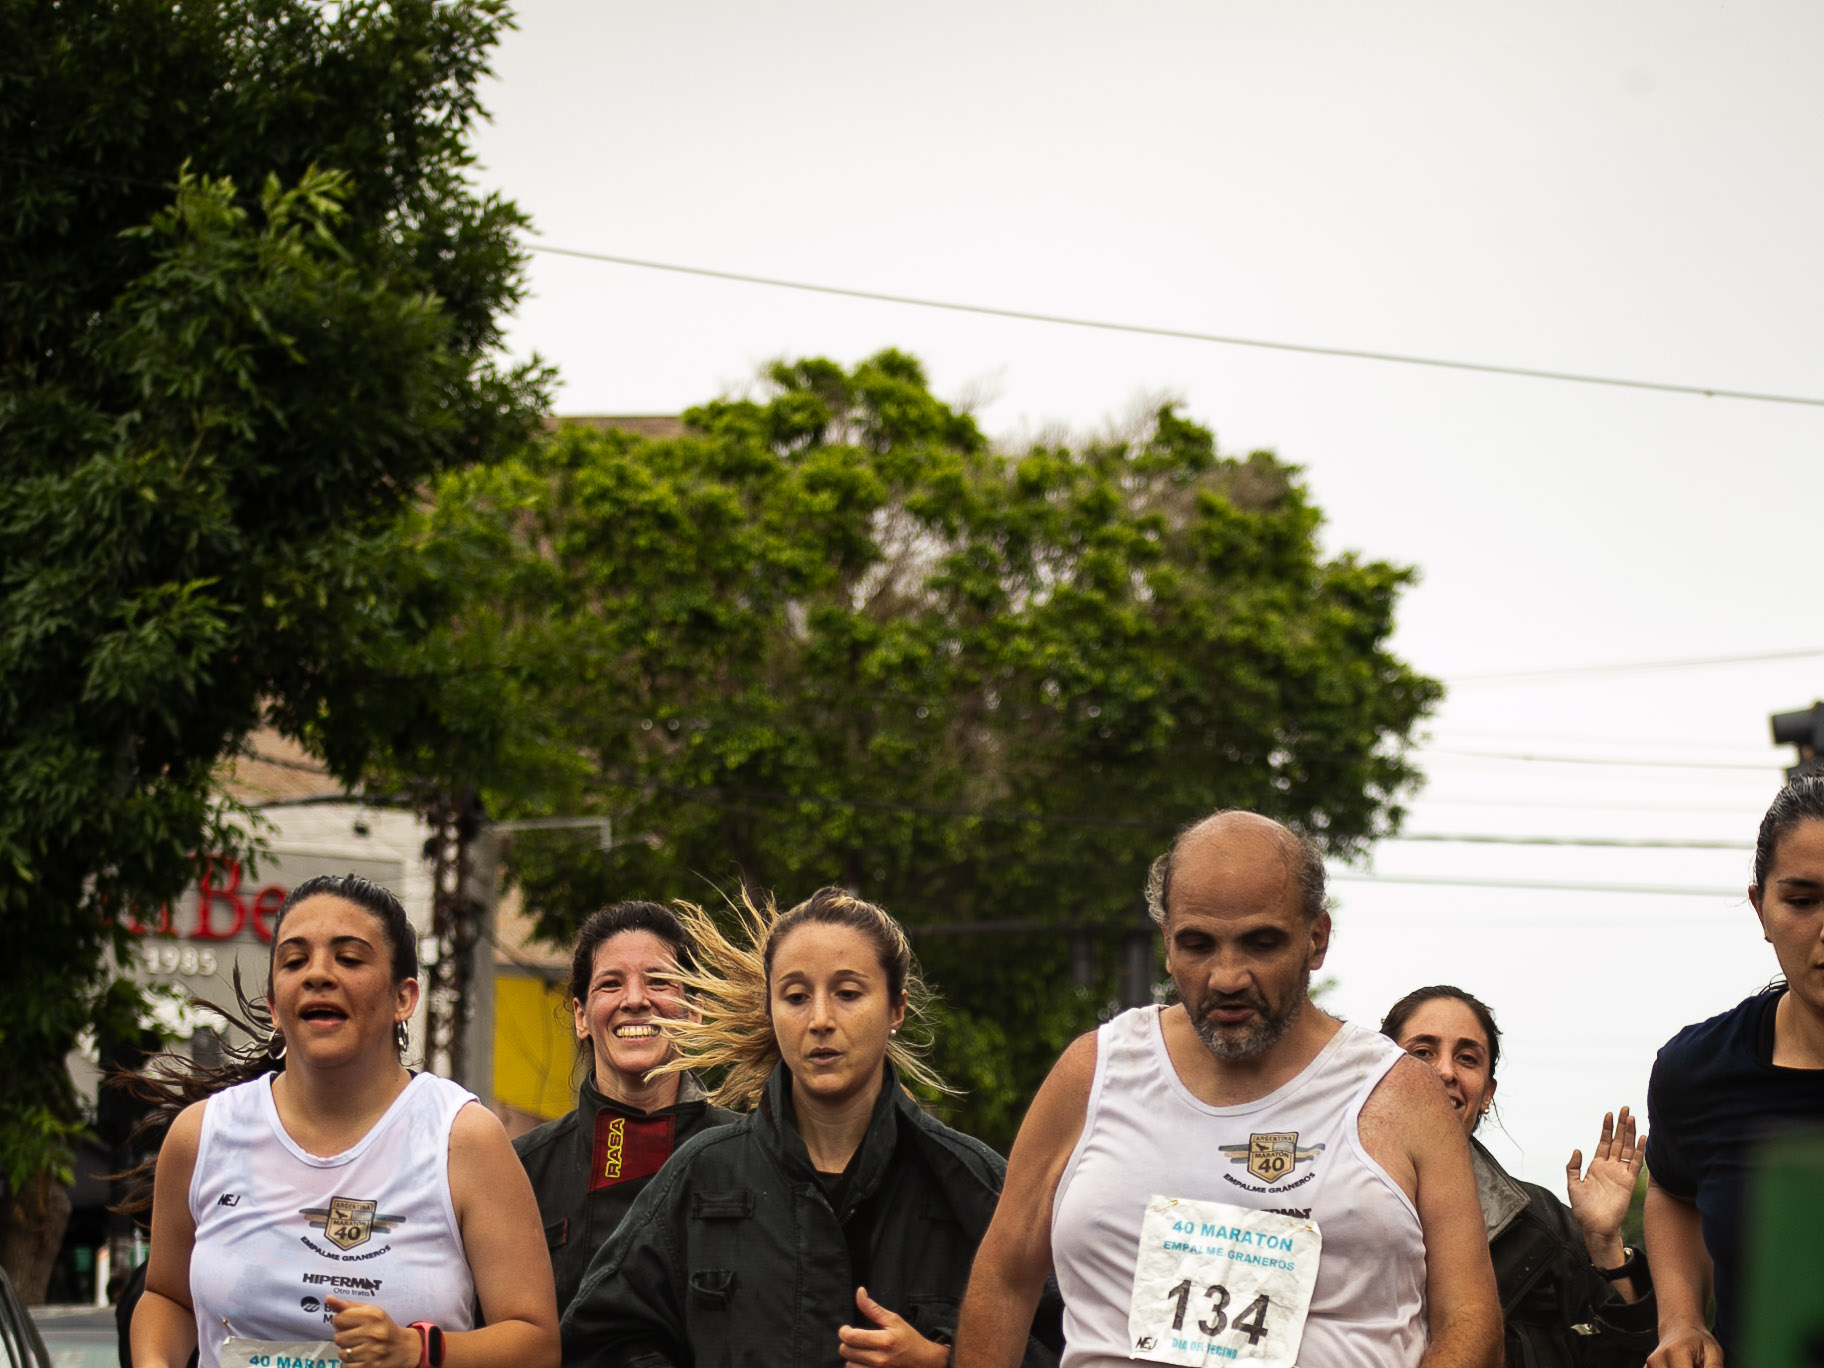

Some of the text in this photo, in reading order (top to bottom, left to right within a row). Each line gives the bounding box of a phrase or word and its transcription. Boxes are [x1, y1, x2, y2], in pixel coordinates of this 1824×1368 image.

[145, 947, 218, 977] 1985
[605, 1117, 625, 1179] RASA
[1258, 1158, 1285, 1173] 40
[1223, 1172, 1315, 1193] EMPALME GRANEROS
[336, 1202, 371, 1211] ARGENTINA
[334, 1226, 361, 1240] 40
[1172, 1220, 1293, 1252] 40 MARATON
[300, 1236, 391, 1261] EMPALME GRANEROS
[1163, 1240, 1295, 1271] EMPALME GRANEROS
[302, 1273, 382, 1291] HIPERMAT
[333, 1287, 350, 1295] Otro
[1168, 1279, 1269, 1345] 134
[1171, 1337, 1187, 1350] DIA
[249, 1355, 270, 1368] 40
